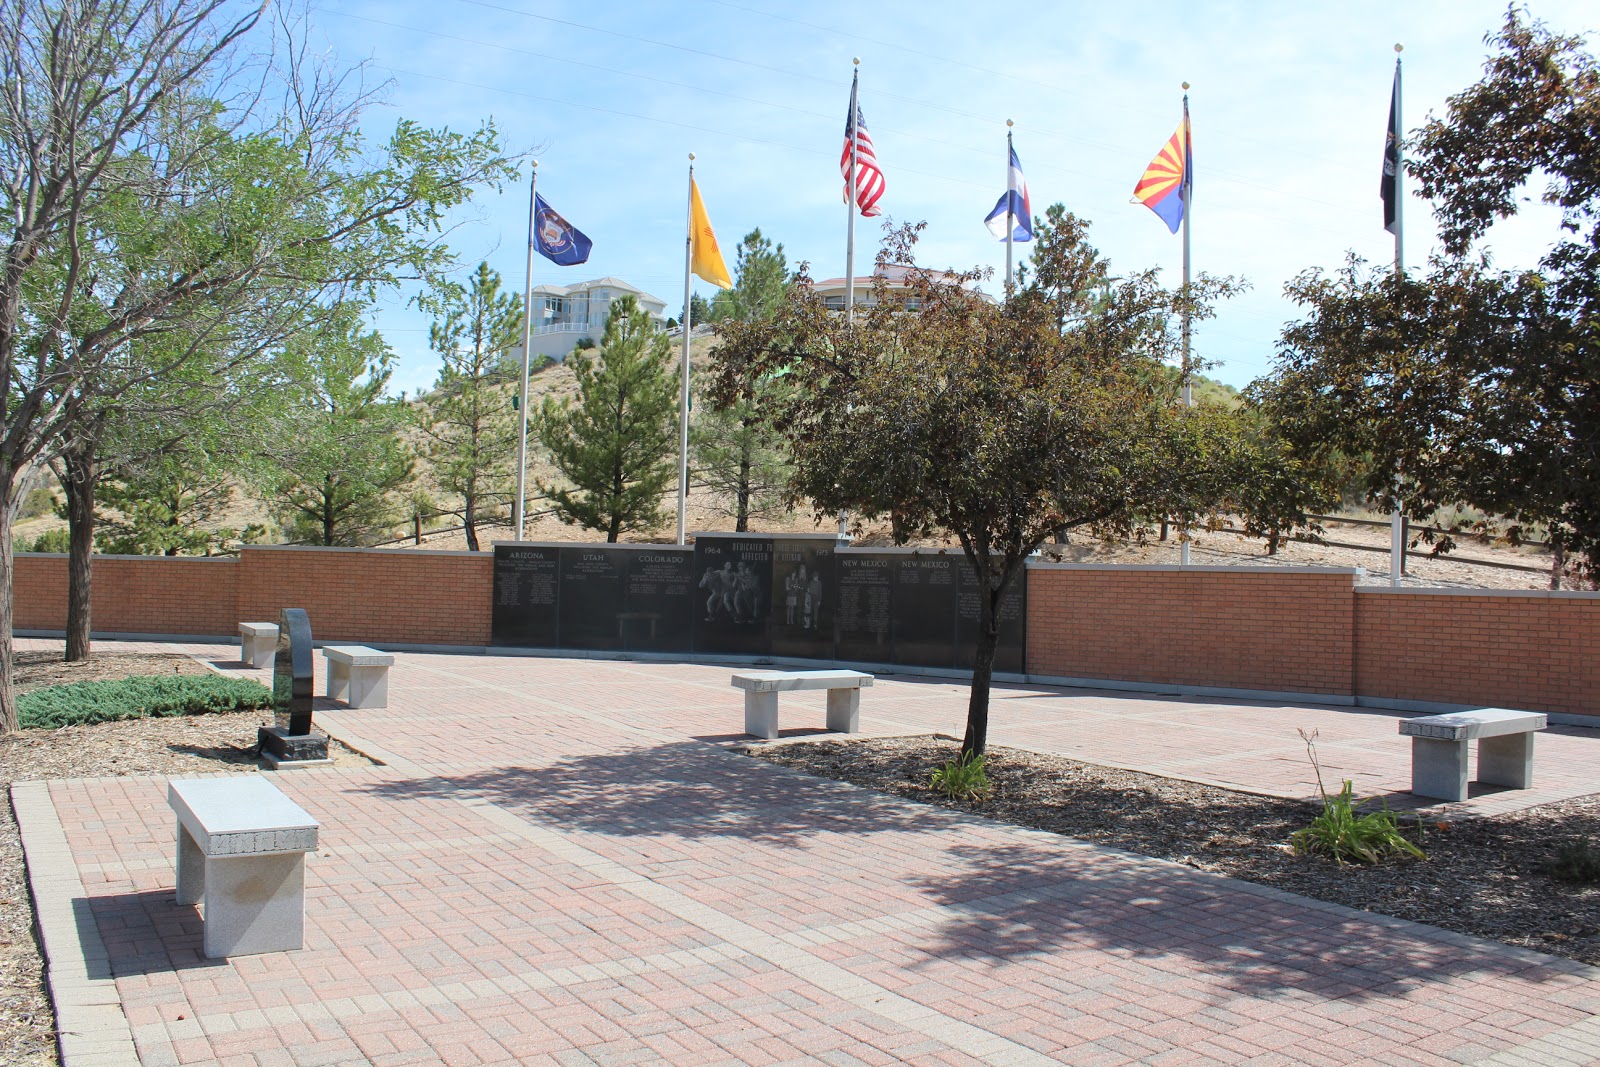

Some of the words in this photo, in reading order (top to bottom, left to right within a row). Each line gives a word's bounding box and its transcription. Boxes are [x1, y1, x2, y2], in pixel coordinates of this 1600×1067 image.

[704, 546, 721, 554] 1964
[732, 542, 763, 552] DEDICATED
[638, 555, 684, 564] COLORADO
[741, 552, 768, 561] AFFECTED
[842, 559, 858, 567] NEW
[861, 560, 888, 568] MEXICO
[902, 560, 918, 568] NEW
[920, 561, 950, 569] MEXICO
